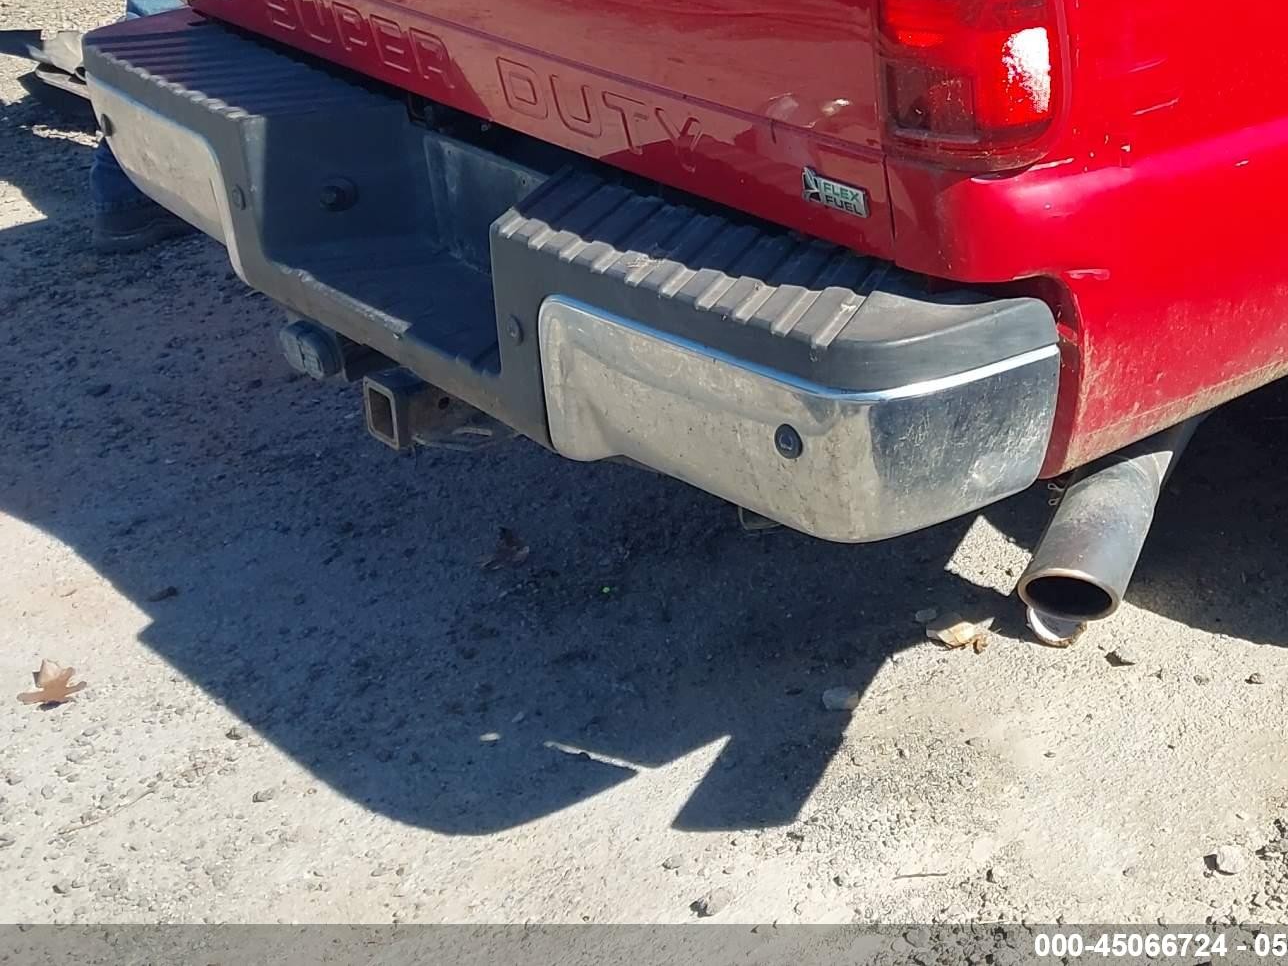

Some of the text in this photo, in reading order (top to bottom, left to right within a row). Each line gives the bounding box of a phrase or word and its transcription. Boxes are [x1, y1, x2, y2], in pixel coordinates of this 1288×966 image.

[496, 55, 703, 172] DUTY
[823, 181, 861, 203] FLEX
[825, 194, 864, 217] FUEL
